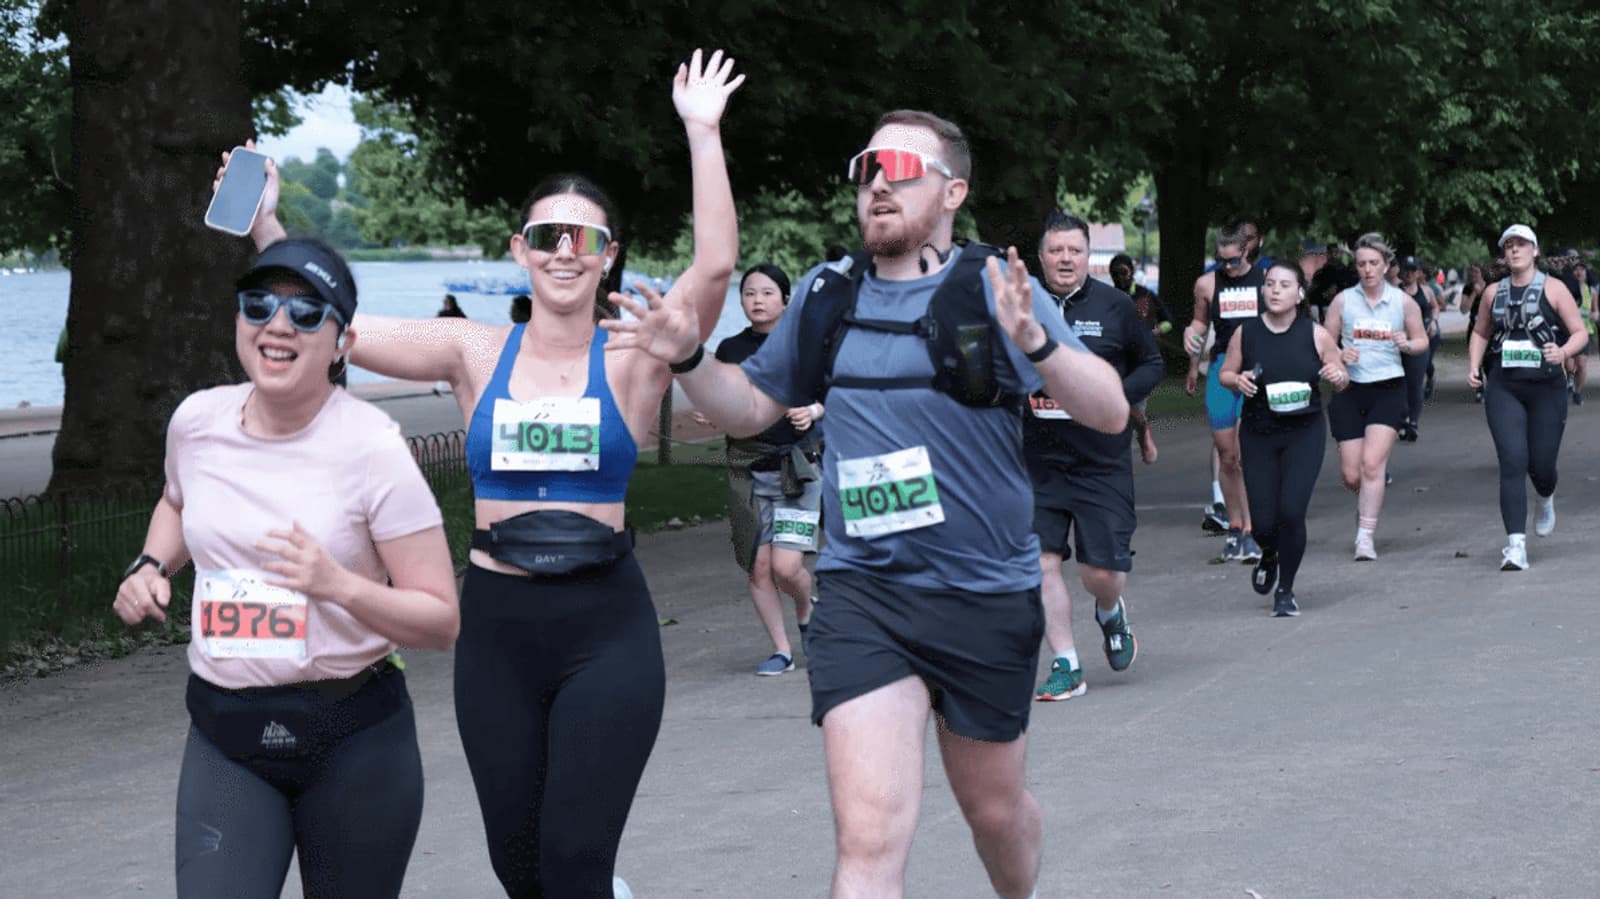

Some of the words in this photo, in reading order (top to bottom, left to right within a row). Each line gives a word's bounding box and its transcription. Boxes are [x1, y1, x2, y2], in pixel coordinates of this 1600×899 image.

[1270, 389, 1310, 404] 4107
[500, 422, 593, 453] 4013
[846, 477, 933, 517] 4012
[535, 554, 556, 564] DAY
[202, 602, 296, 637] 1976
